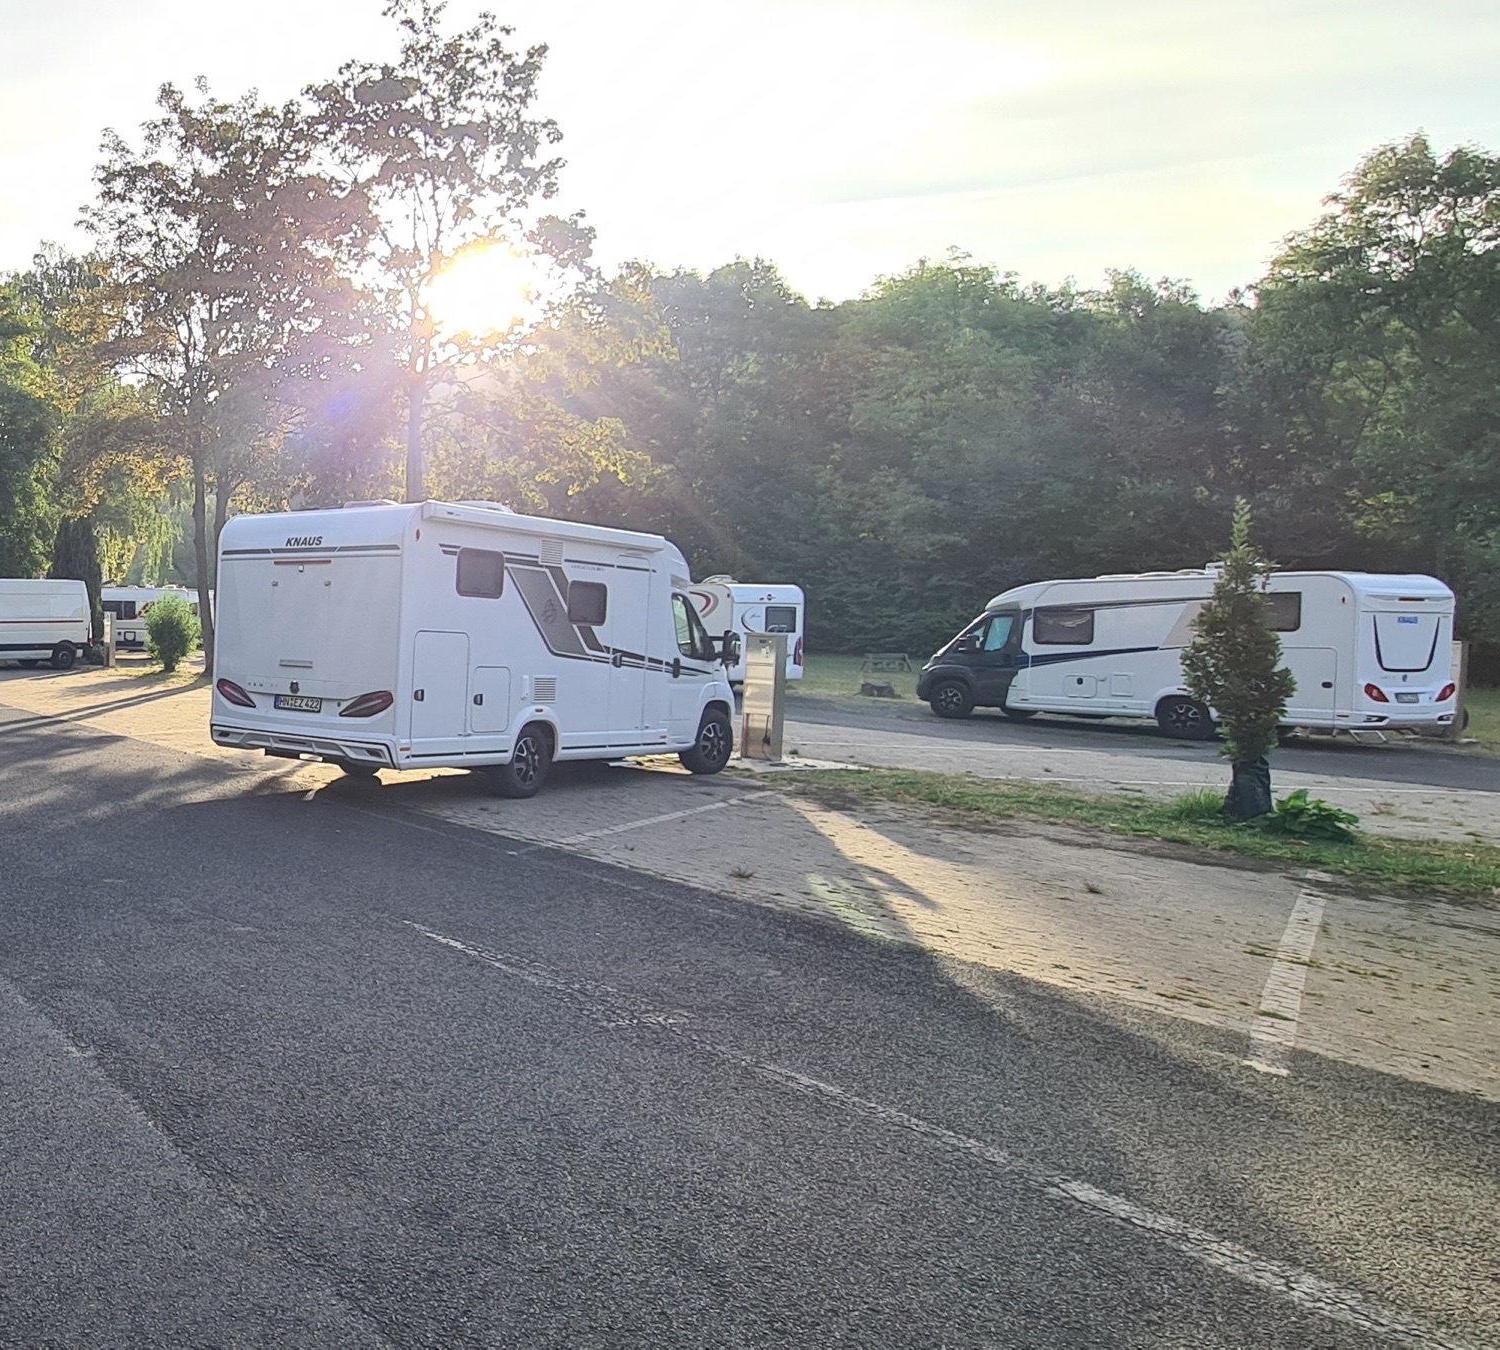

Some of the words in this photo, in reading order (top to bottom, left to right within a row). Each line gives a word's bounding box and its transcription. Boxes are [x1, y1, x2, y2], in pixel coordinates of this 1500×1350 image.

[285, 536, 323, 547] KNAUS
[294, 698, 303, 708] EZ
[305, 699, 320, 709] 422
